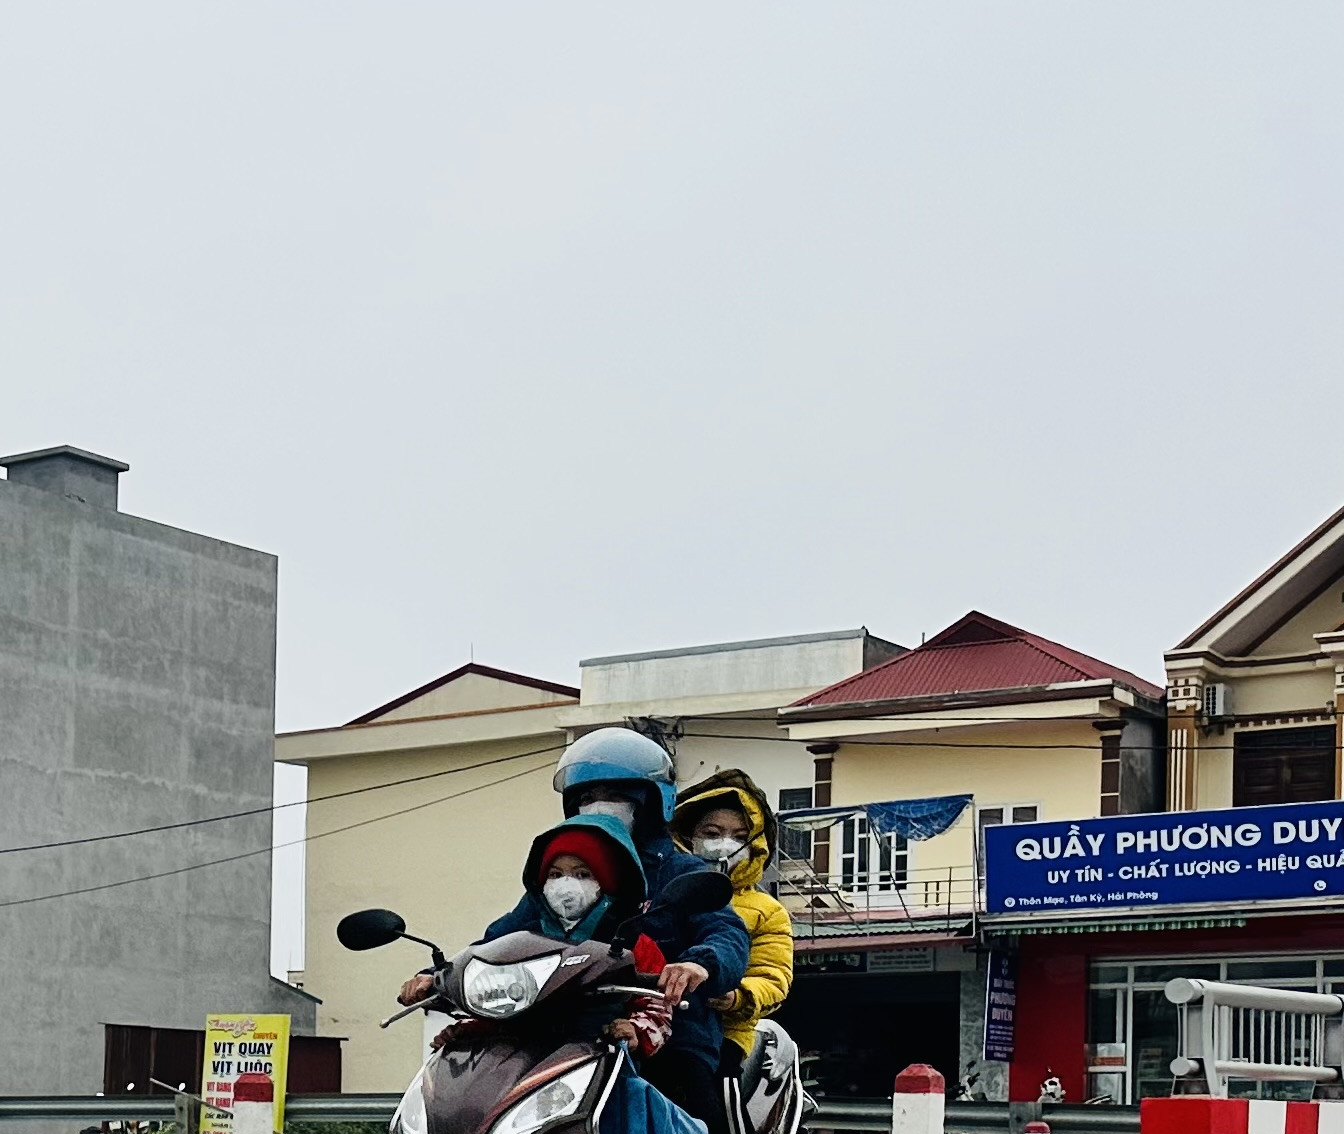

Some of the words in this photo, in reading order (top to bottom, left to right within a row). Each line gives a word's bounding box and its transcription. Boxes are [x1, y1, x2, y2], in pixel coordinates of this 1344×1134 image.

[1015, 824, 1105, 861] QUẦY
[1116, 823, 1262, 855] PHƯƠNG
[1273, 818, 1343, 844] DUY
[1047, 870, 1071, 884] UY
[1075, 865, 1103, 883] TÍN
[1118, 859, 1169, 880] CHẤT
[1174, 858, 1240, 879] LƯỢNG
[1257, 853, 1300, 874] HIỆU
[1126, 890, 1159, 901] Phòng
[213, 1041, 234, 1058] VỊT
[238, 1042, 273, 1057] QUAY
[211, 1060, 233, 1077] VỊT
